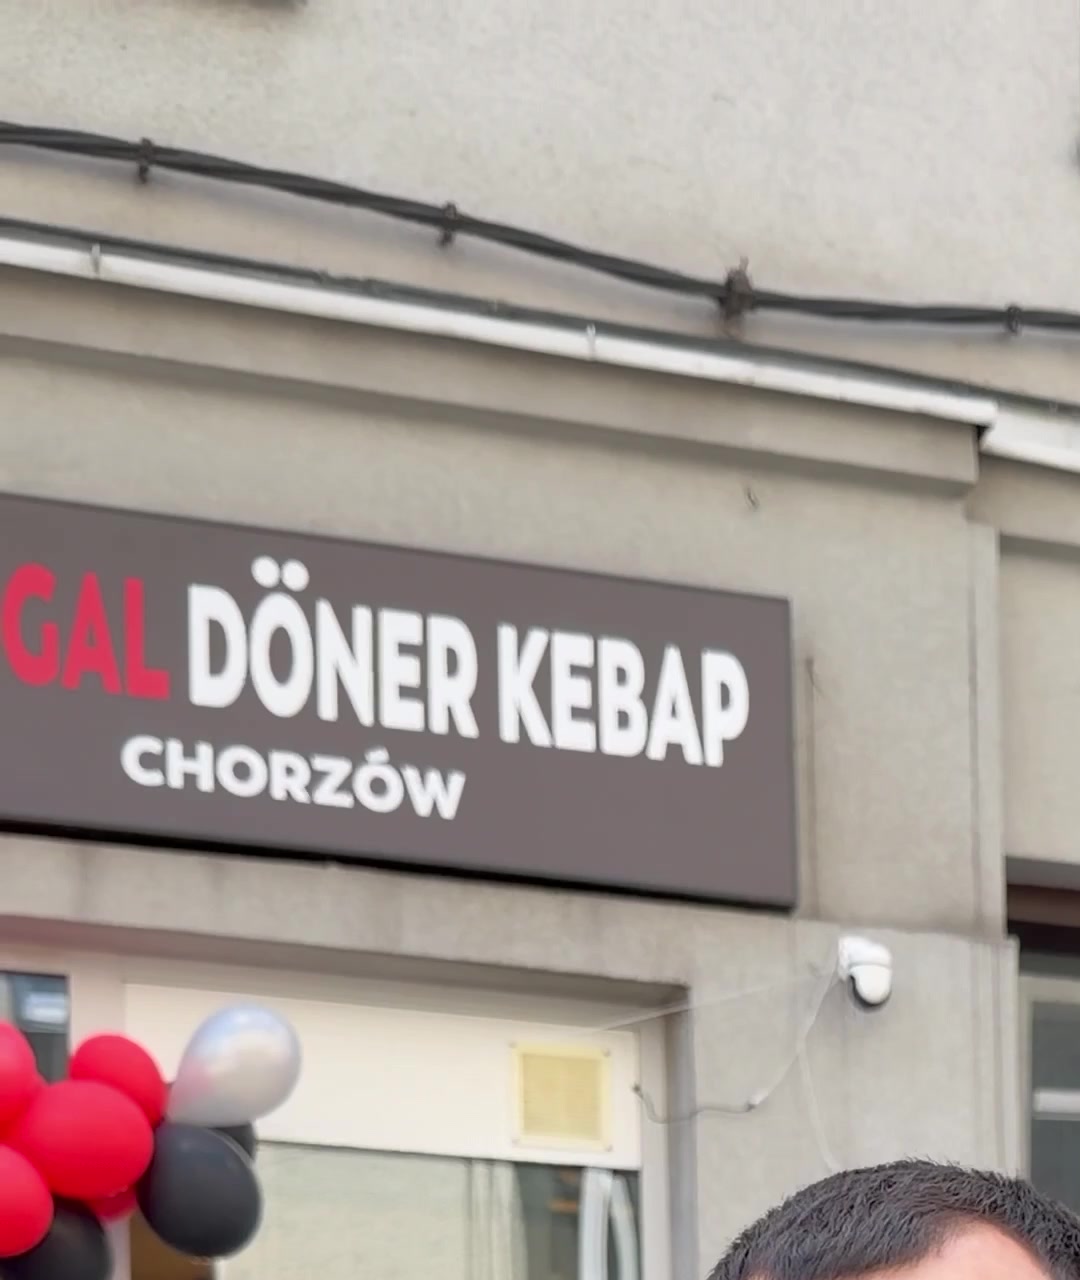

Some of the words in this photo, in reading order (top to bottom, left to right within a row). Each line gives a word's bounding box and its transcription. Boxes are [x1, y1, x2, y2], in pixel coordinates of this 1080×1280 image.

[187, 556, 480, 739] DÖNER
[496, 624, 750, 768] KEBAP
[120, 735, 467, 821] CHORZÓW
